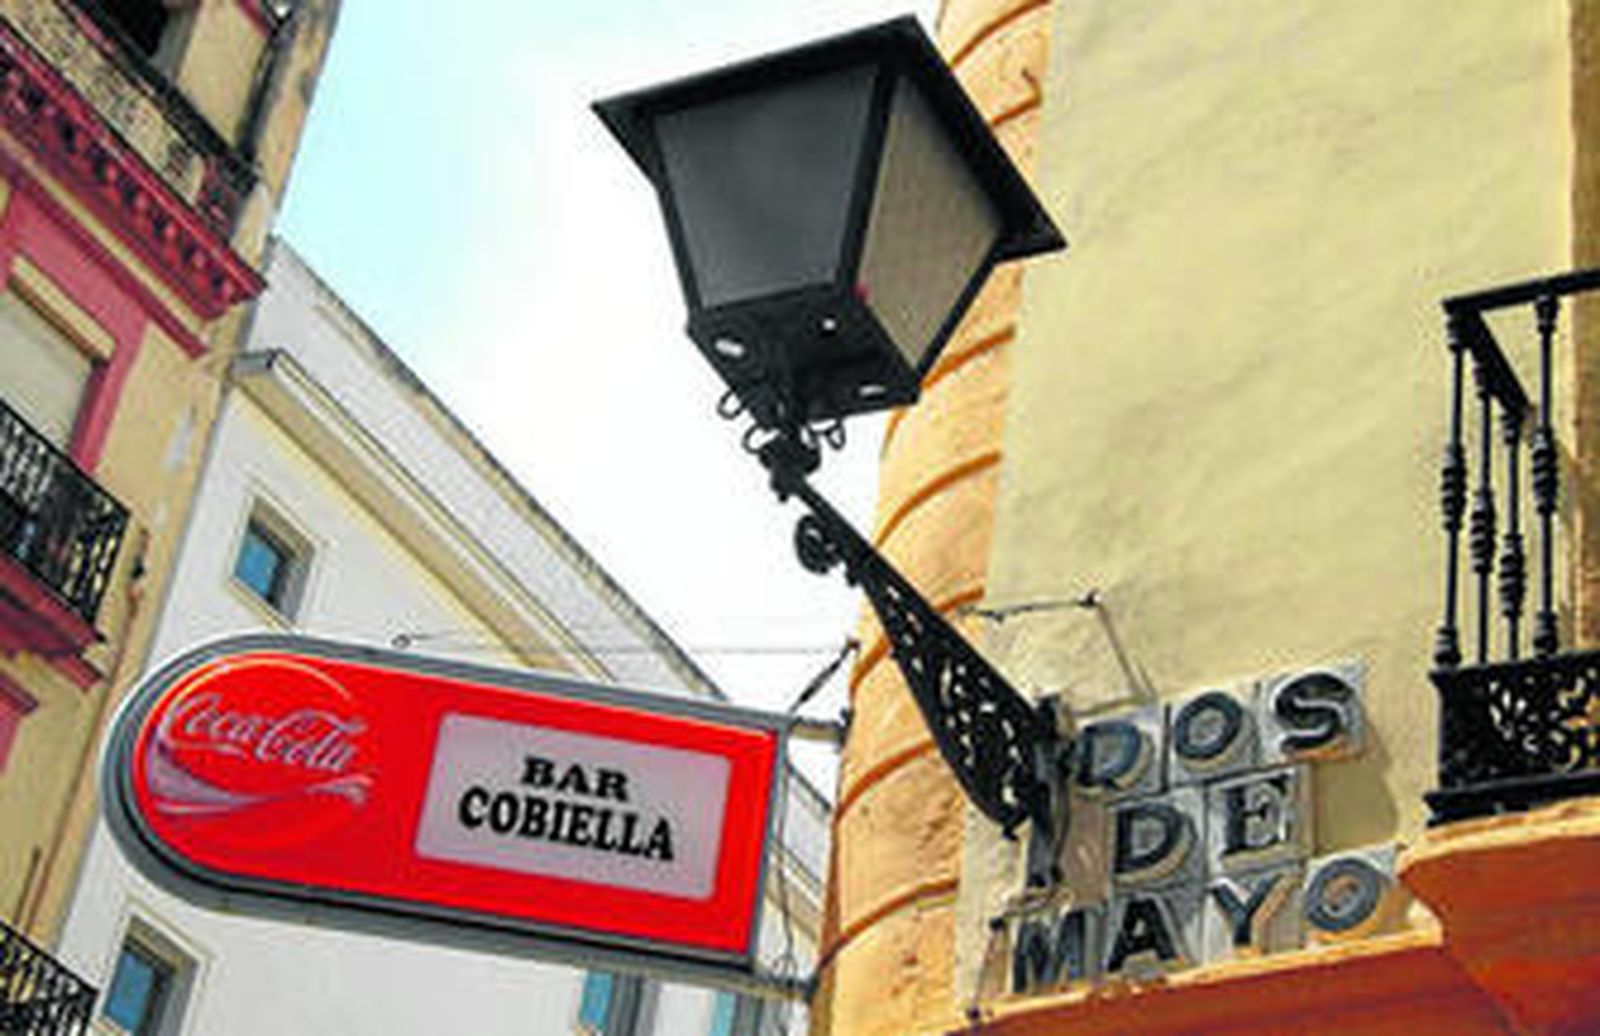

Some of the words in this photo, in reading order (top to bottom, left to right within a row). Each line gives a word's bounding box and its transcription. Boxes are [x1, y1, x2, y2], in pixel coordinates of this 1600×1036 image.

[1077, 672, 1356, 787] DOS
[459, 786, 675, 861] COBIELLA
[521, 757, 628, 802] BAR
[1114, 776, 1293, 873] DE
[1013, 858, 1382, 992] MAYO
